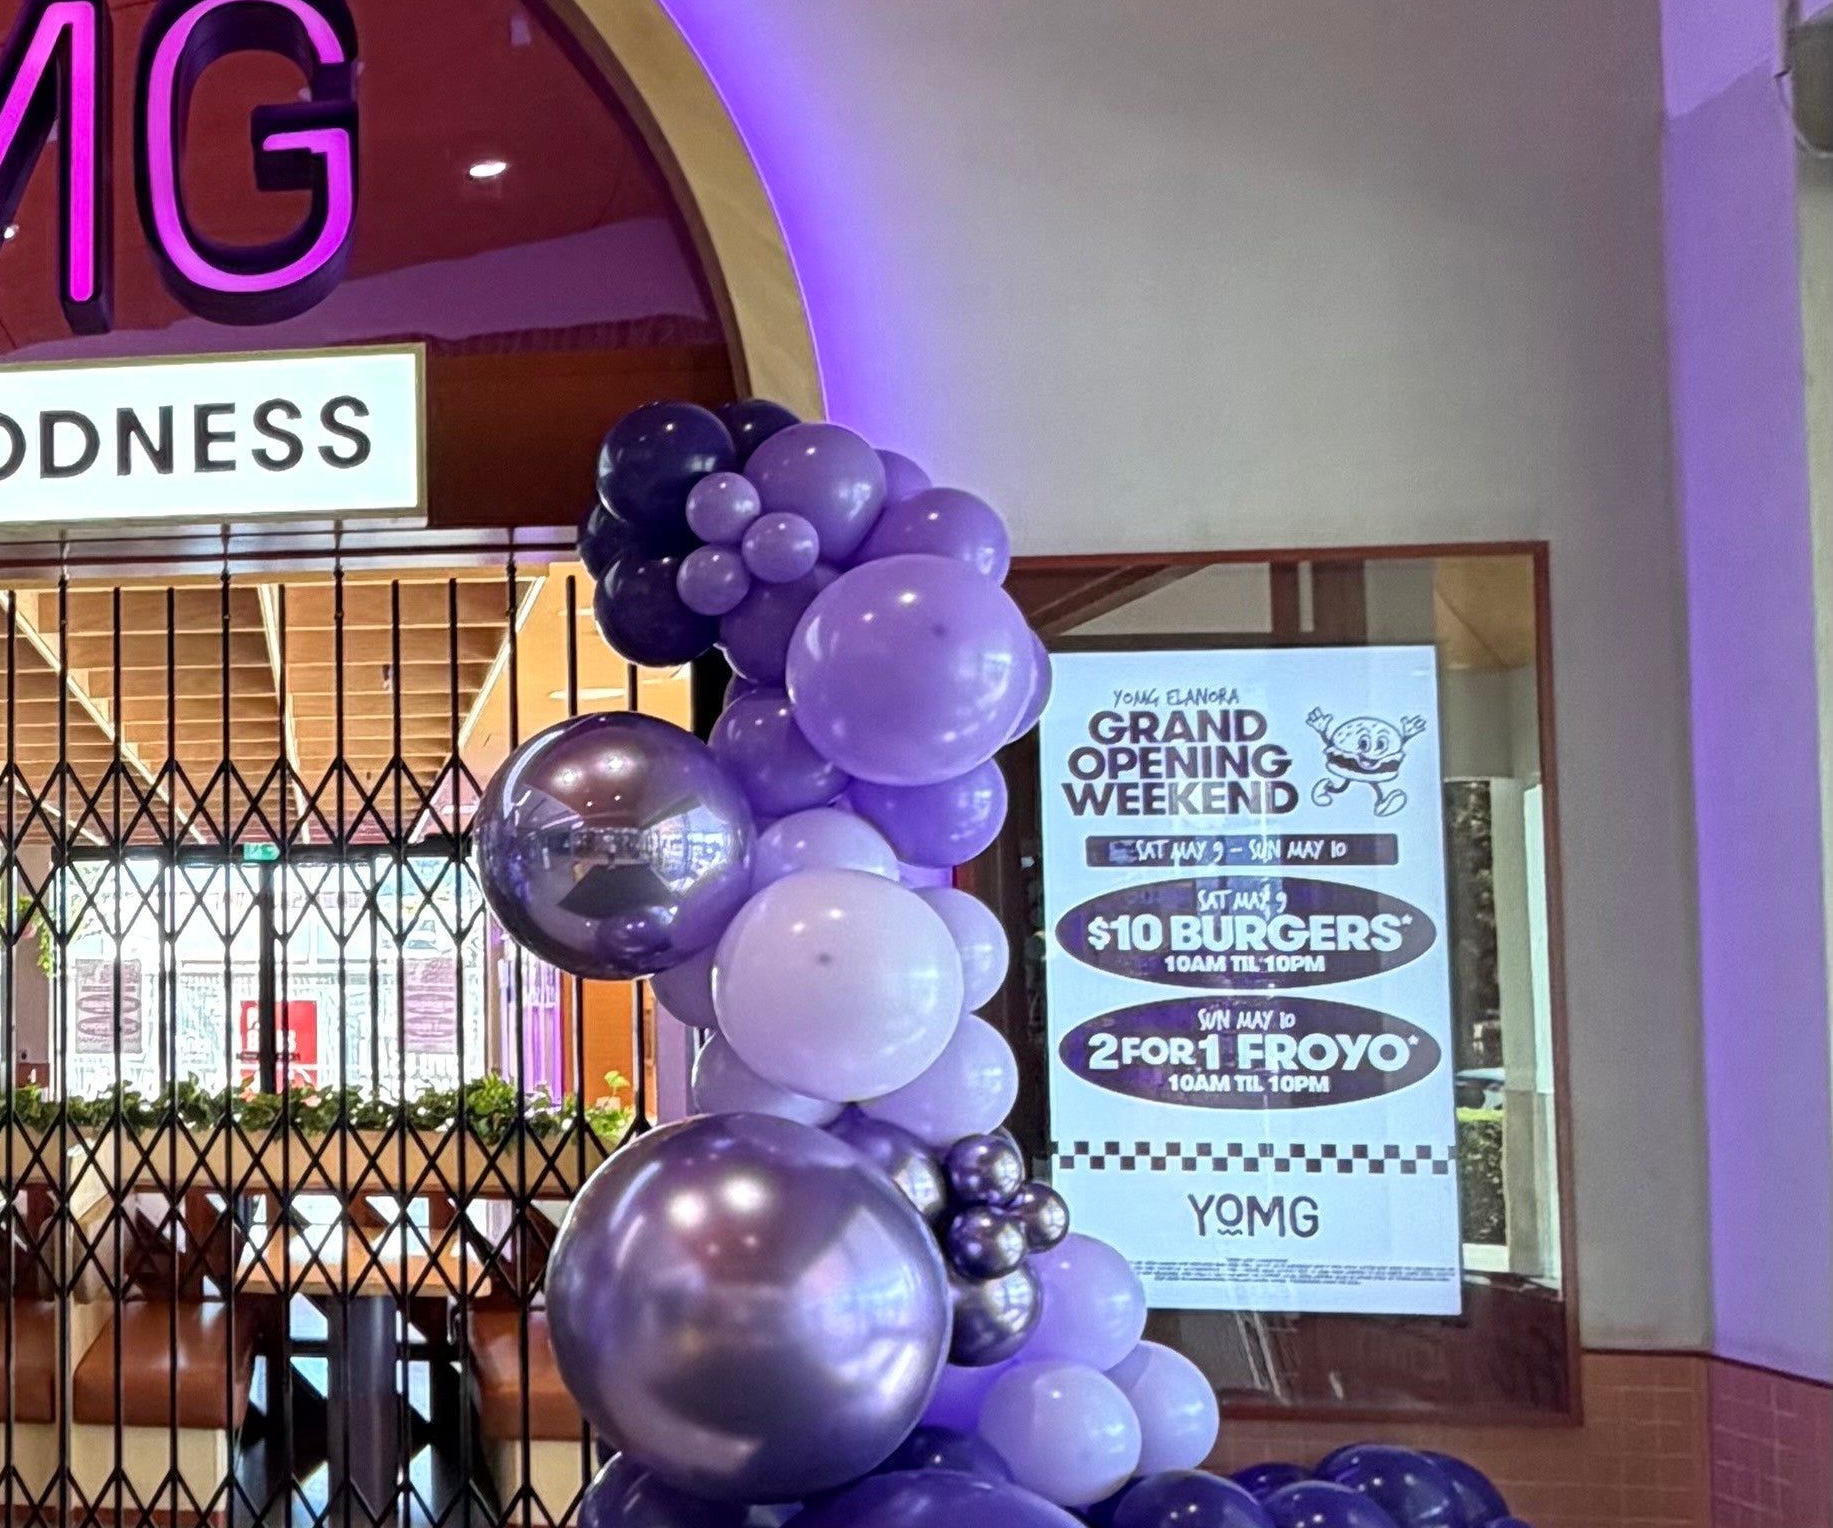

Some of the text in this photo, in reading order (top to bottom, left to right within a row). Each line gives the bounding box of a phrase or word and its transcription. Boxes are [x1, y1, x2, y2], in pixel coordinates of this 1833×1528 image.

[1114, 688, 1240, 708] YOMG ELANORA
[1088, 709, 1268, 745] GRAND
[1067, 743, 1294, 781] OPENING
[1061, 780, 1300, 817] WEEKEND
[1135, 840, 1168, 861] SAT
[1169, 840, 1207, 862] MAY
[1212, 843, 1224, 862] 9
[1248, 839, 1282, 861] SUN
[1286, 839, 1325, 860] MAY
[1331, 840, 1348, 858] 10
[1197, 888, 1288, 912] SAT MAY 9
[1087, 913, 1164, 952] $10
[1164, 955, 1326, 973] 10AM TIL 10PM
[1198, 1008, 1296, 1032] SUN MAY 10
[1168, 1074, 1330, 1094] 10AM TIL 10PM
[1188, 1193, 1320, 1238] YOMG
